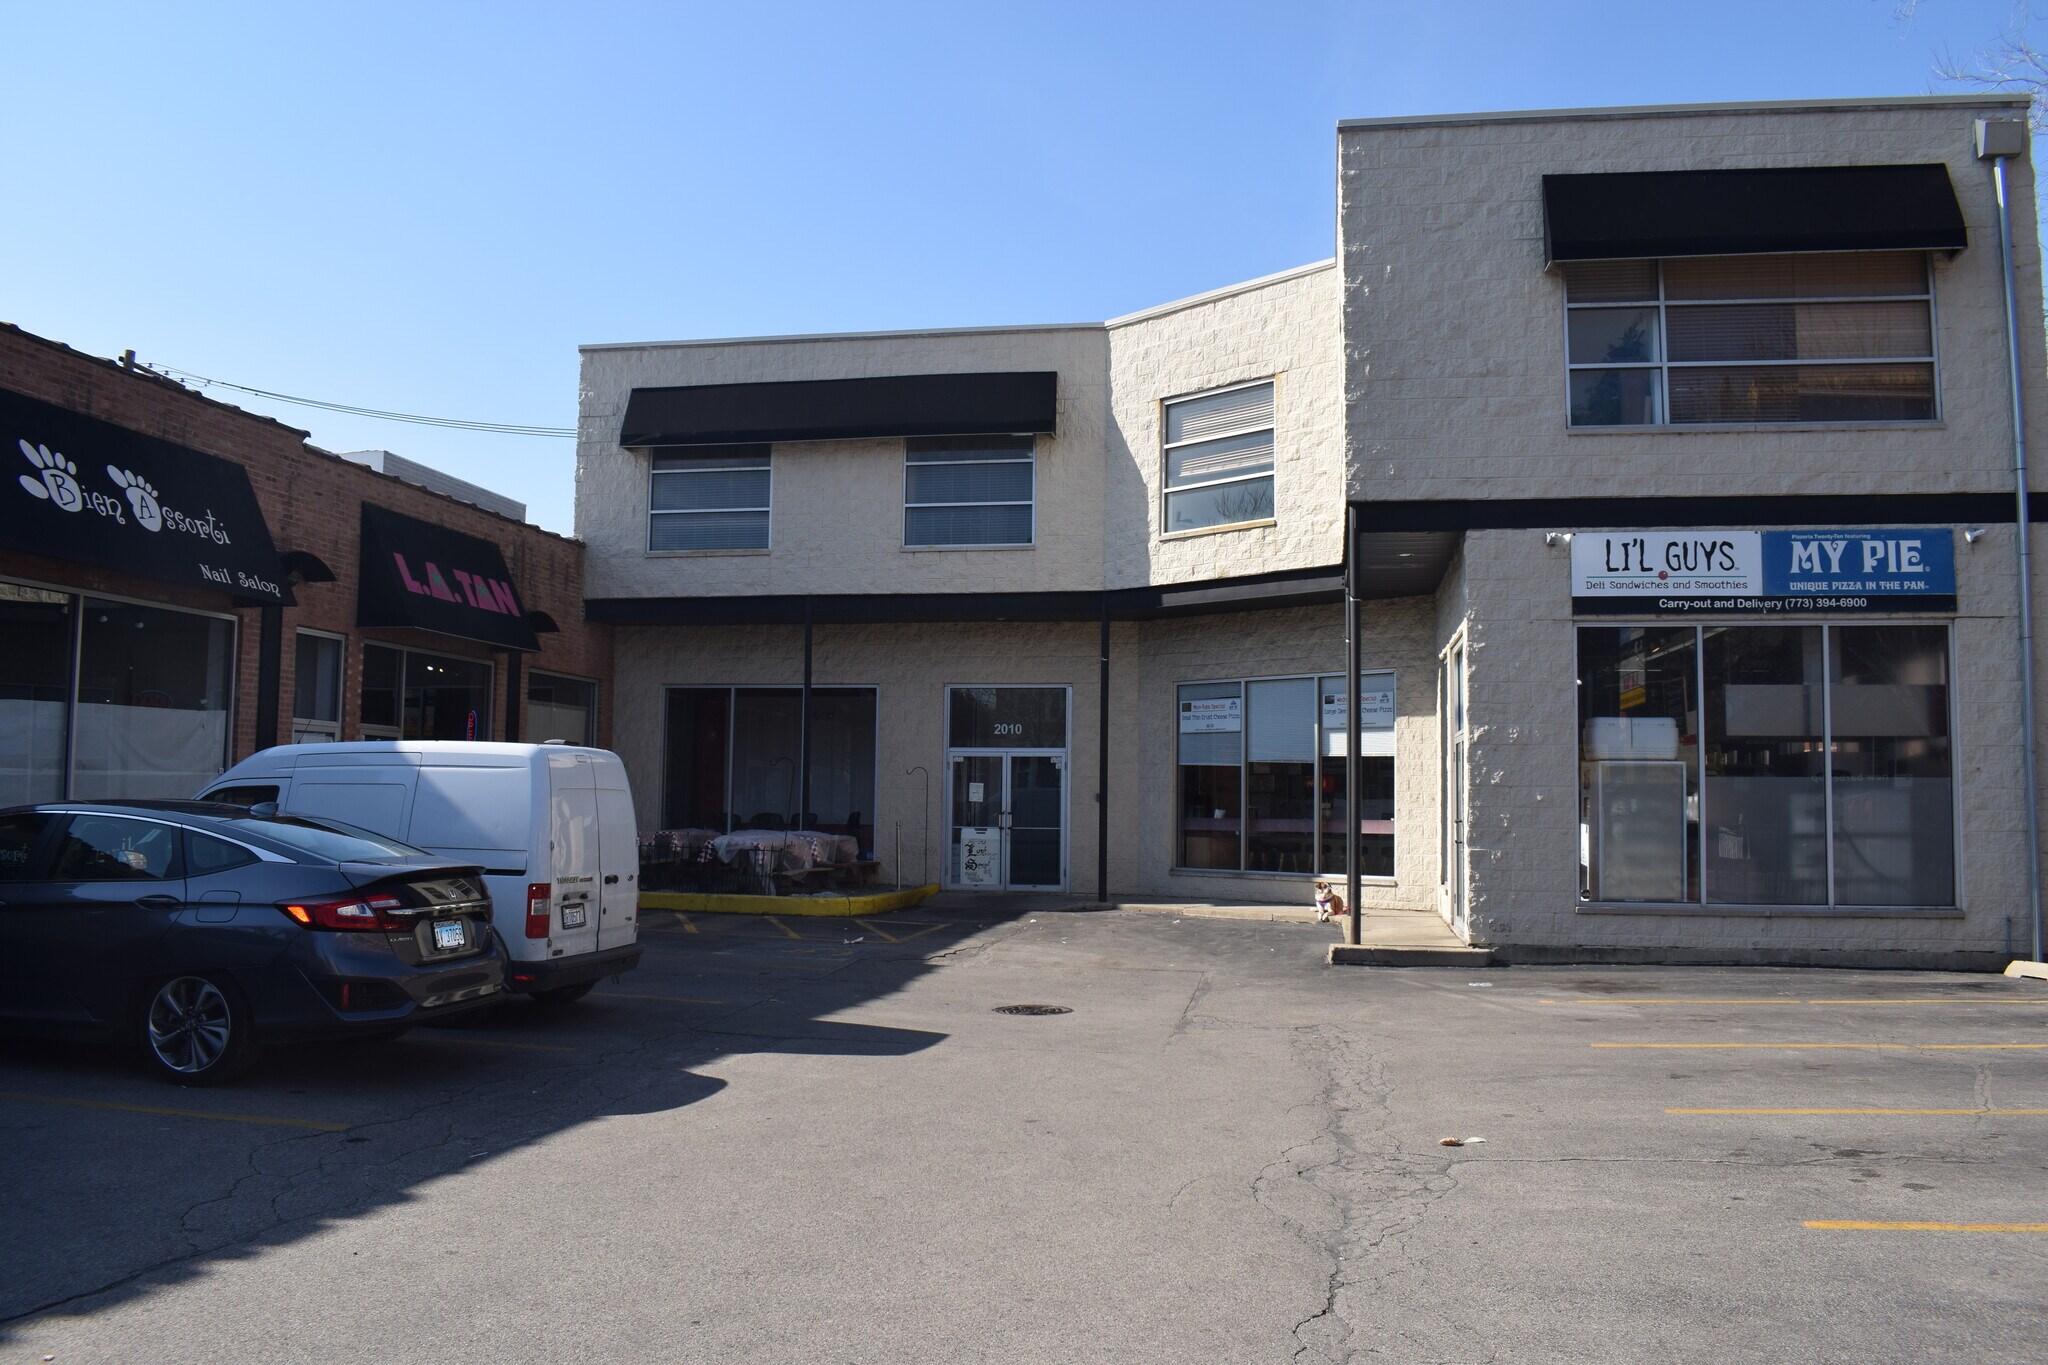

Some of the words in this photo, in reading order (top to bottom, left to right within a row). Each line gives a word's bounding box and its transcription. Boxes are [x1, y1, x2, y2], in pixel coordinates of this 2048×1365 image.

[50, 473, 126, 525] Bien
[138, 494, 231, 545] Assorti
[1605, 538, 1654, 572] LI'L
[1665, 540, 1735, 572] GUYS
[1789, 540, 1849, 573] MY
[1861, 539, 1924, 573] PIE
[198, 563, 233, 584] Nail
[238, 571, 282, 598] Salon
[1586, 580, 1605, 590] Deli
[1609, 580, 1669, 589] Sandwiches
[1672, 580, 1691, 589] and
[1694, 580, 1748, 589] Smoothies
[1789, 581, 1829, 592] UNIQUE
[1832, 581, 1862, 590] PIZZA
[1865, 581, 1877, 590] IN
[1879, 581, 1901, 590] THE
[1903, 581, 1925, 590] PAN
[1658, 598, 1712, 610] Carry-out
[1713, 598, 1735, 608] and
[1737, 598, 1783, 610] Delivery
[1785, 598, 1814, 610] (773)
[1816, 598, 1867, 608] 394-6900
[993, 723, 1023, 735] 2010
